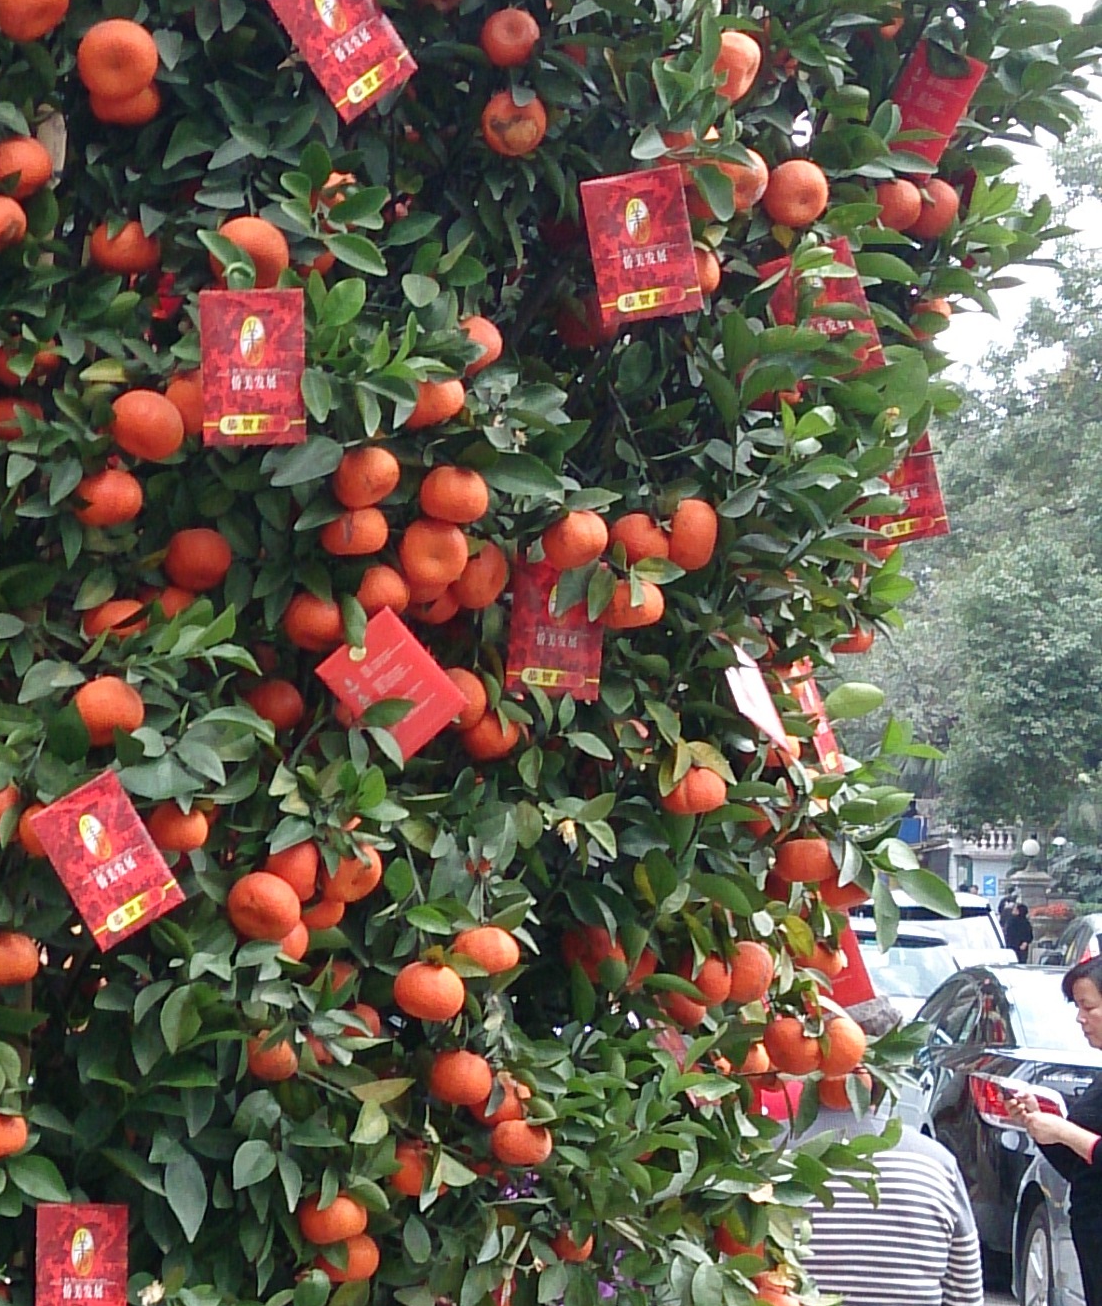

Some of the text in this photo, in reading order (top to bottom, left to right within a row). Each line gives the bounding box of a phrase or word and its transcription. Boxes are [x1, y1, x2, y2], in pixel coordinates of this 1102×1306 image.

[622, 249, 667, 270] 侨美发展
[231, 374, 277, 391] 侨美发展
[536, 632, 578, 648] 侨美发展
[527, 669, 580, 686] 恭贺新
[95, 855, 138, 889] 侨美发展
[62, 1282, 104, 1300] 侨美发展
